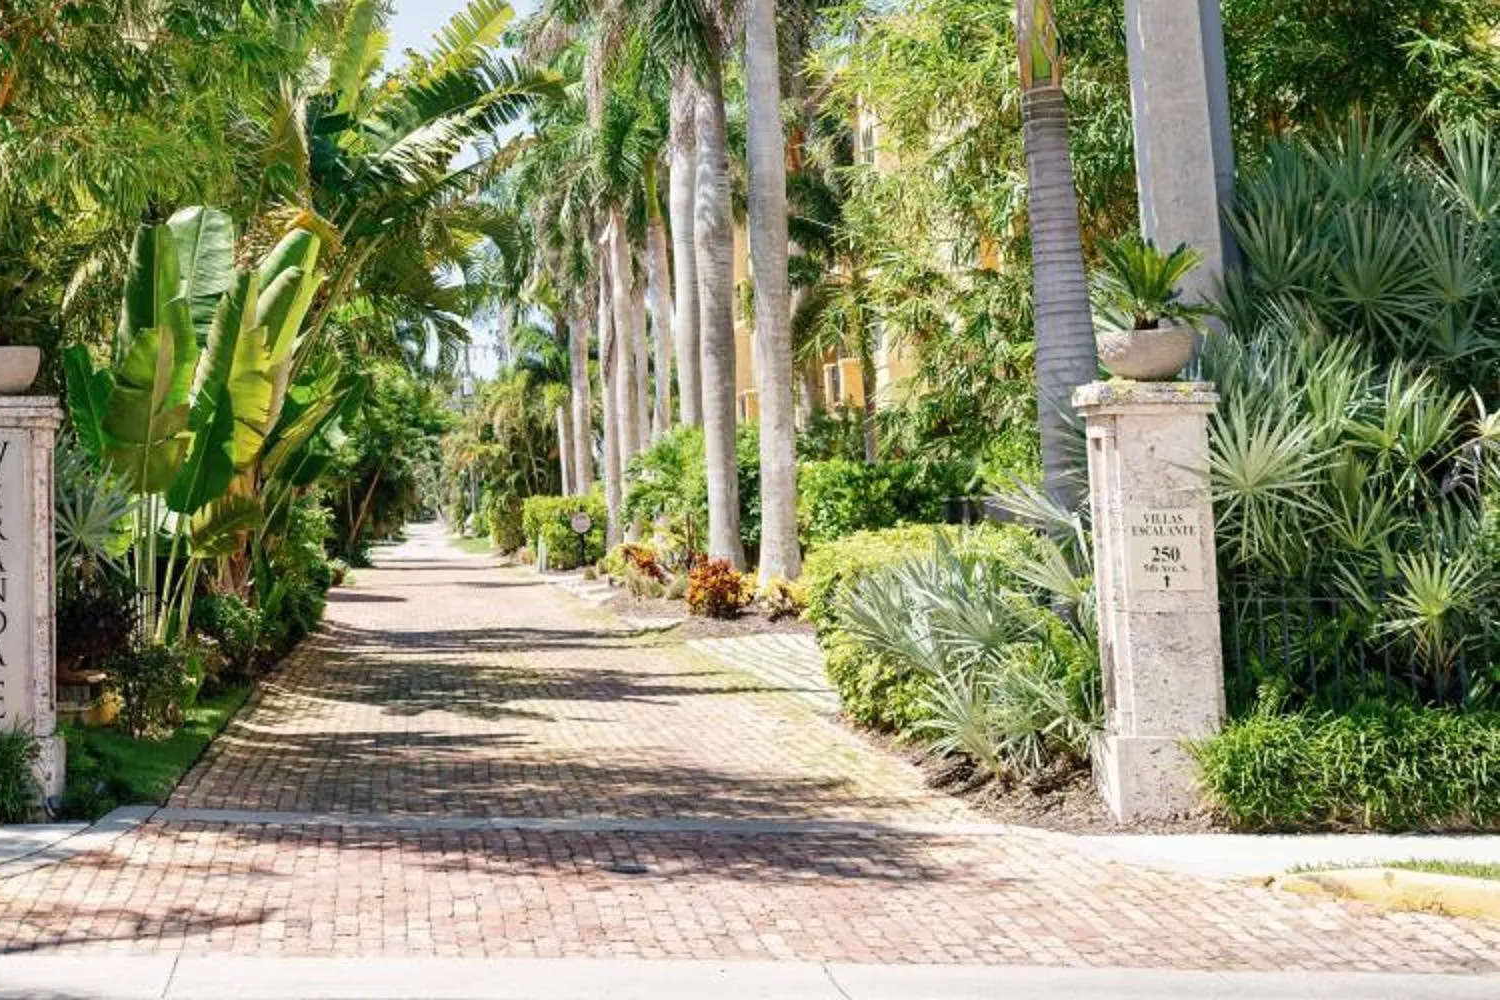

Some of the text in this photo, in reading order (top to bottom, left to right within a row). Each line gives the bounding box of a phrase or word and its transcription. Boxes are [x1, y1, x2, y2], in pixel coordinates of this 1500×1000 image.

[1143, 513, 1185, 525] VILLAS
[1131, 525, 1197, 537] ESCALANTE
[1151, 545, 1181, 562] 250
